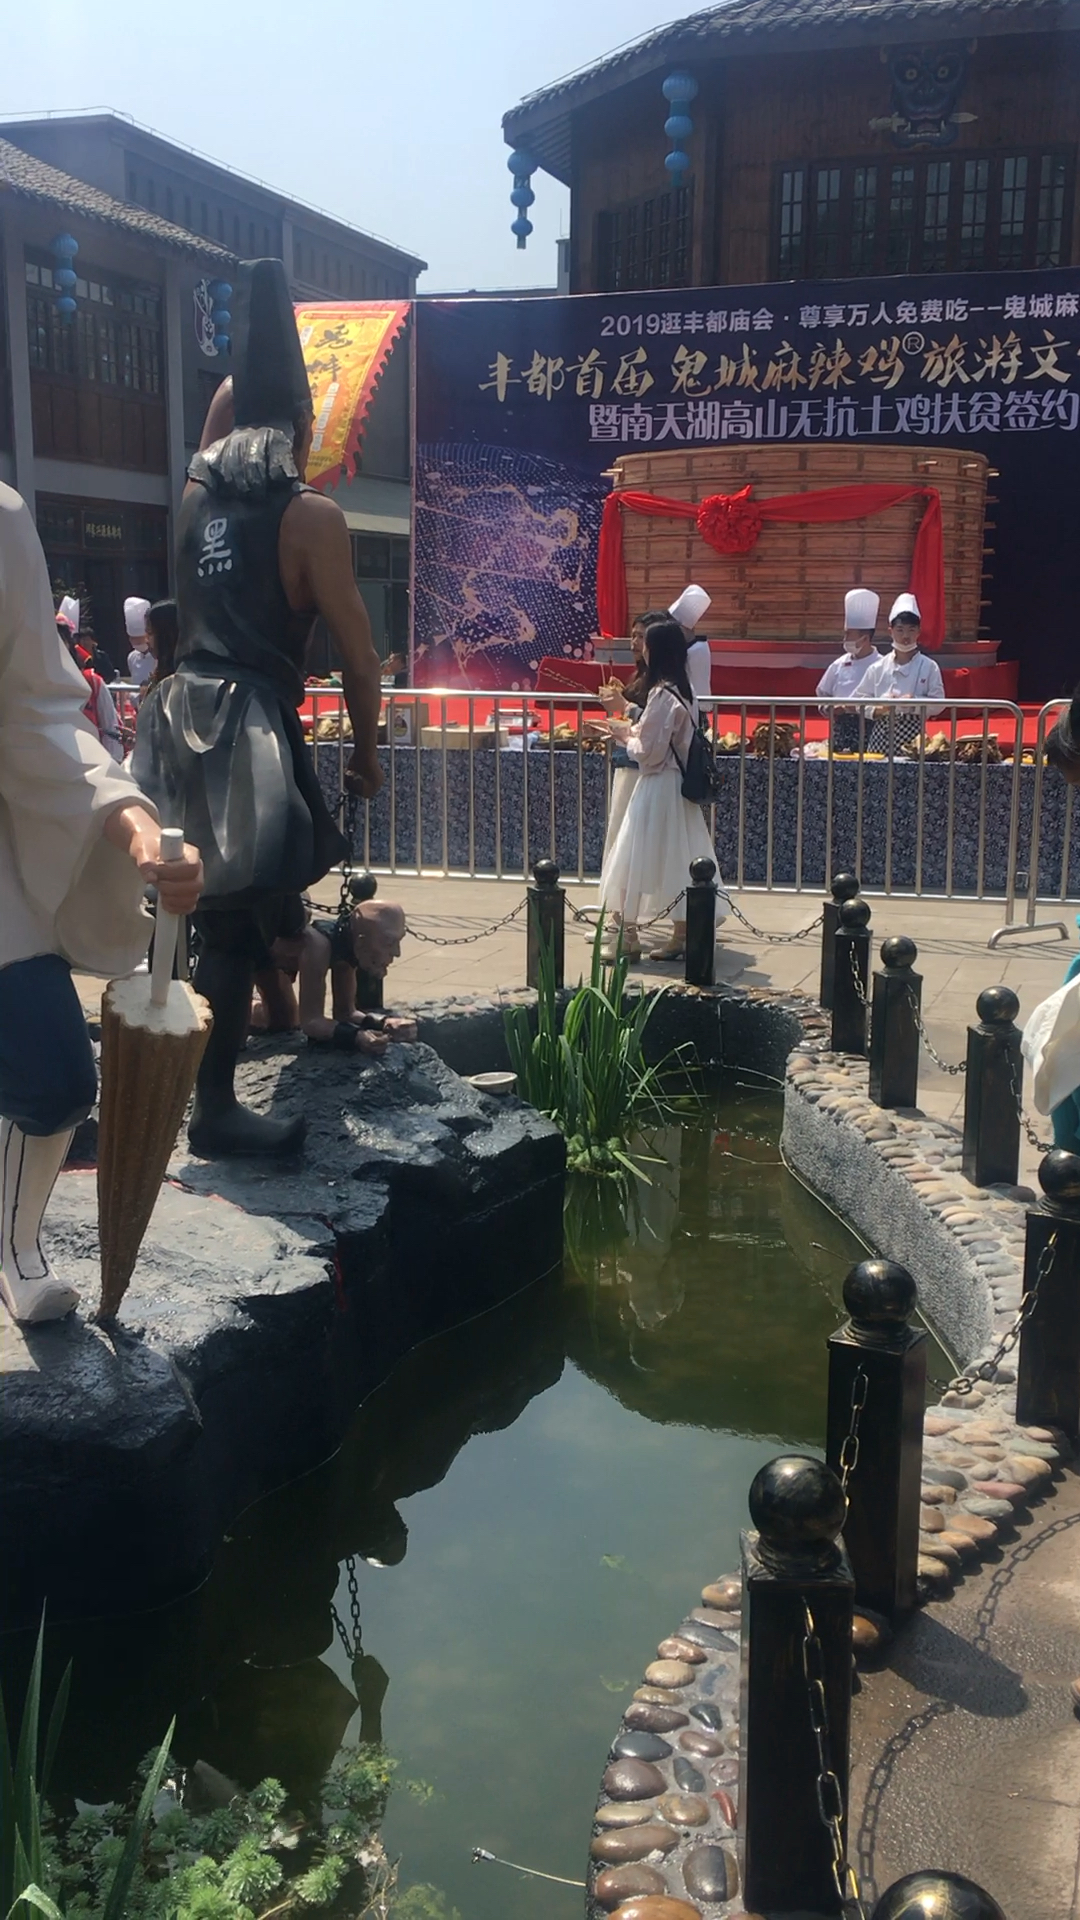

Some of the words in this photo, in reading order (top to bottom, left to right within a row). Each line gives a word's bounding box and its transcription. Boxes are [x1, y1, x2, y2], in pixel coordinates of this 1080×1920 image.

[478, 345, 655, 402] 丰都首届
[588, 389, 1080, 442] 暨南天湖高山无抗土鸡扶贫签约
[197, 517, 233, 578] 黑
